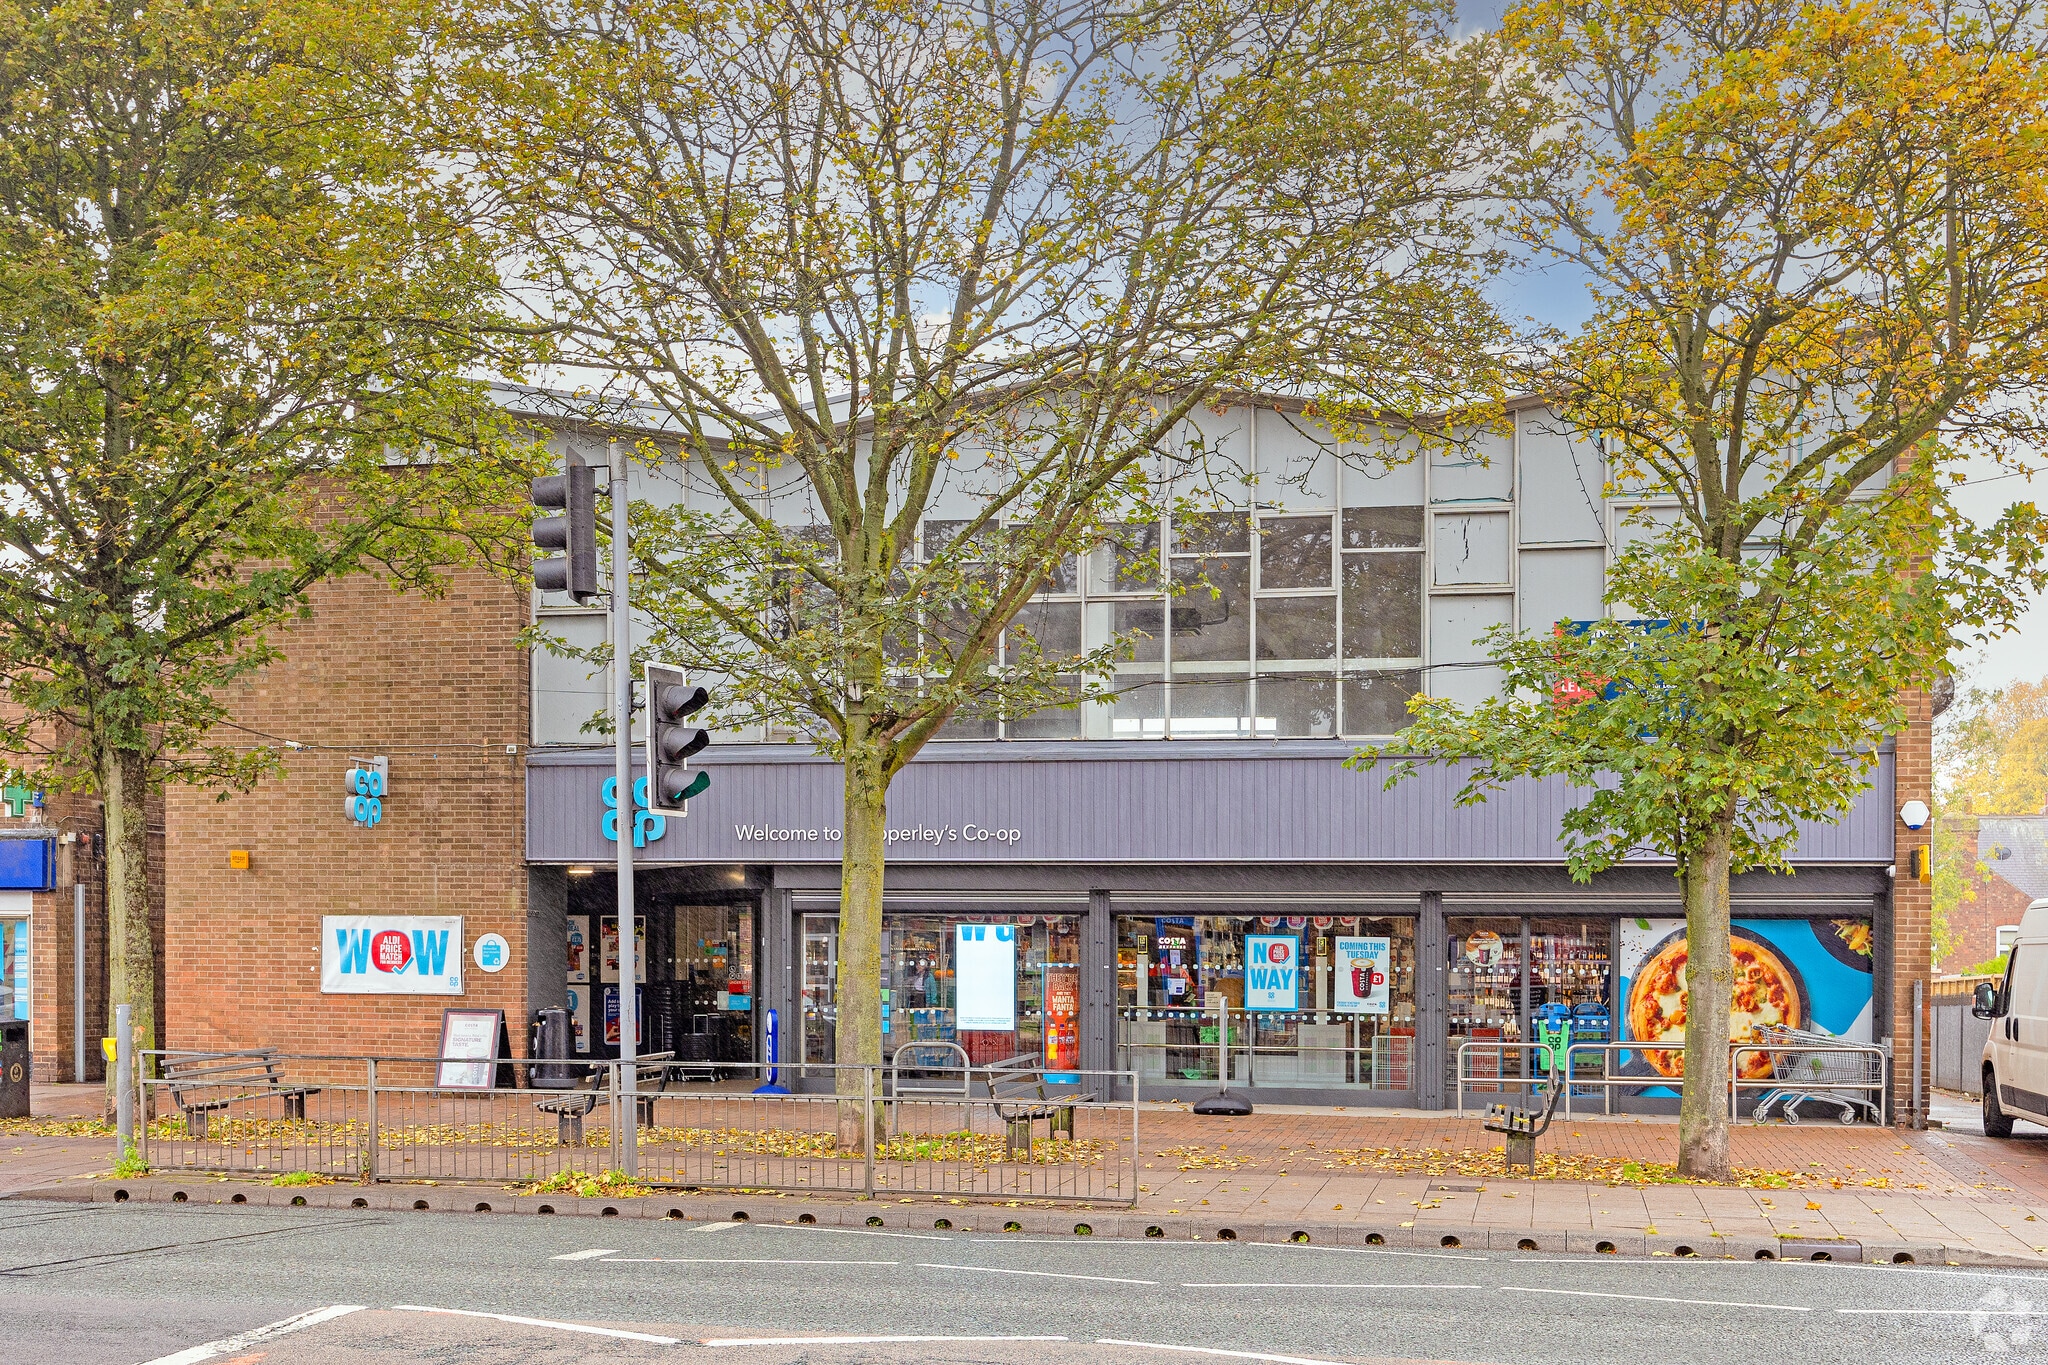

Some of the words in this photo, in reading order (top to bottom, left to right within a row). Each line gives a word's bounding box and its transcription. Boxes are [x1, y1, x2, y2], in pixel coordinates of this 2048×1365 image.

[735, 823, 819, 842] Welcome
[823, 825, 842, 842] to
[883, 824, 958, 846] perley's
[962, 823, 1021, 847] Co-op
[383, 935, 401, 944] ALDI
[1158, 937, 1186, 945] COSTA
[380, 944, 402, 953] PRICE
[1339, 941, 1368, 951] COMING
[1368, 942, 1386, 951] THIS
[380, 952, 402, 961] MATCH
[1346, 950, 1379, 959] TUESDAY
[1250, 968, 1294, 990] WAY
[1372, 974, 1382, 983] £1
[1052, 995, 1075, 1004] WANTA
[1053, 1003, 1074, 1012] FANTA
